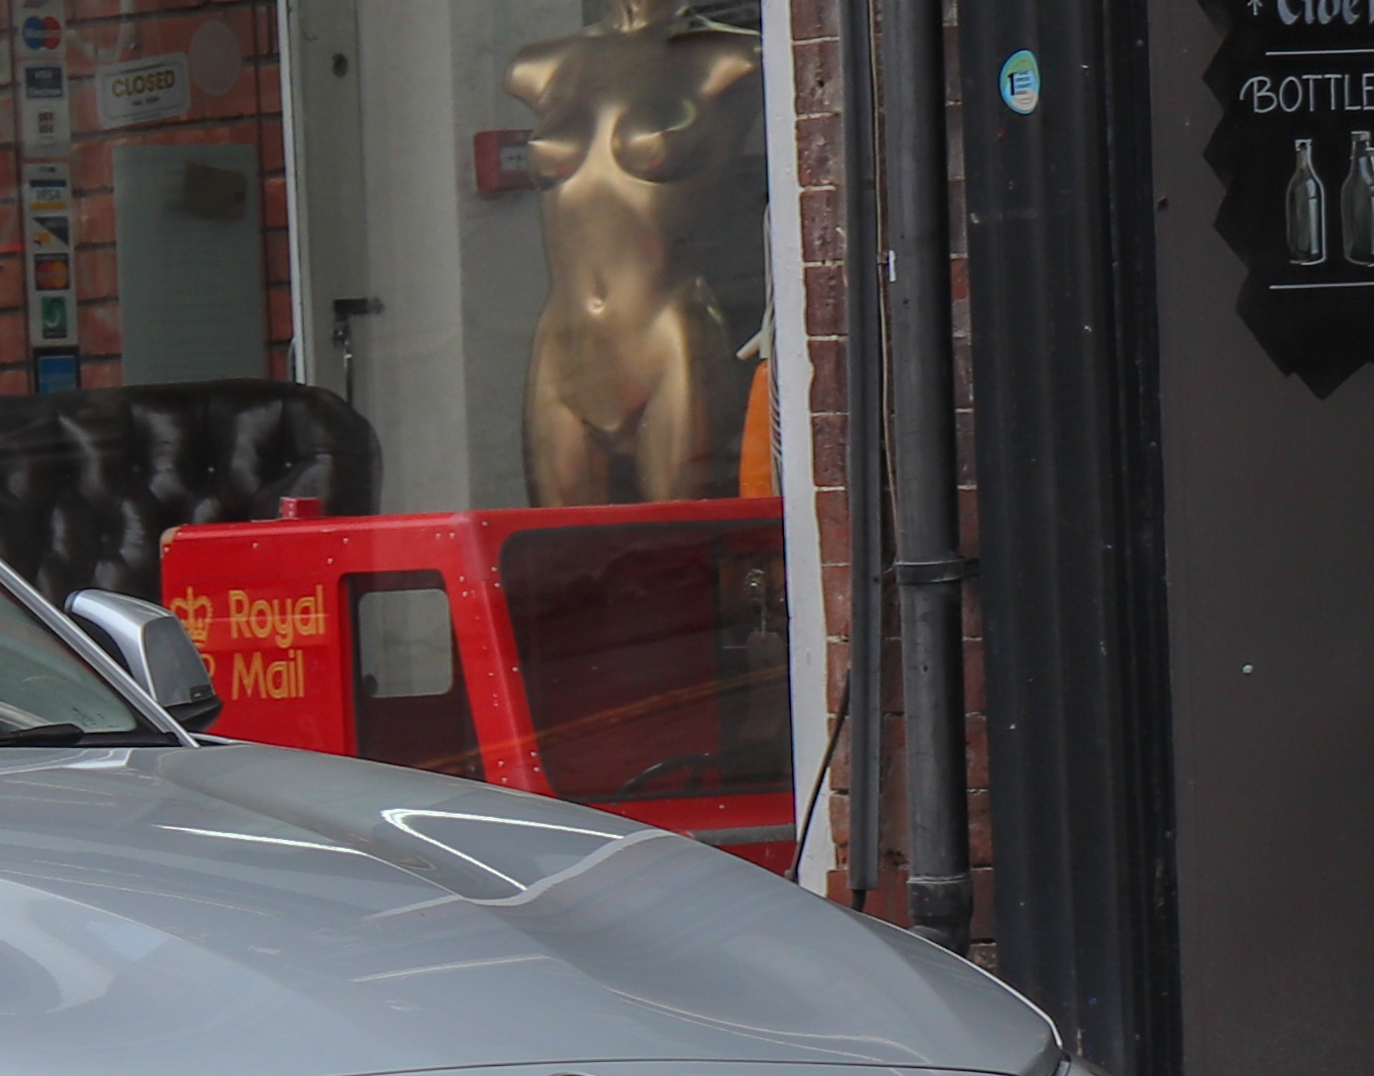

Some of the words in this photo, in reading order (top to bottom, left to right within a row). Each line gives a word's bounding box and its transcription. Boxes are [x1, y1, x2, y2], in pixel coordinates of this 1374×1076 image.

[111, 69, 176, 98] CLOSED
[1239, 73, 1374, 114] BOTTLE
[228, 584, 326, 647] Royal
[231, 648, 305, 700] Mail
